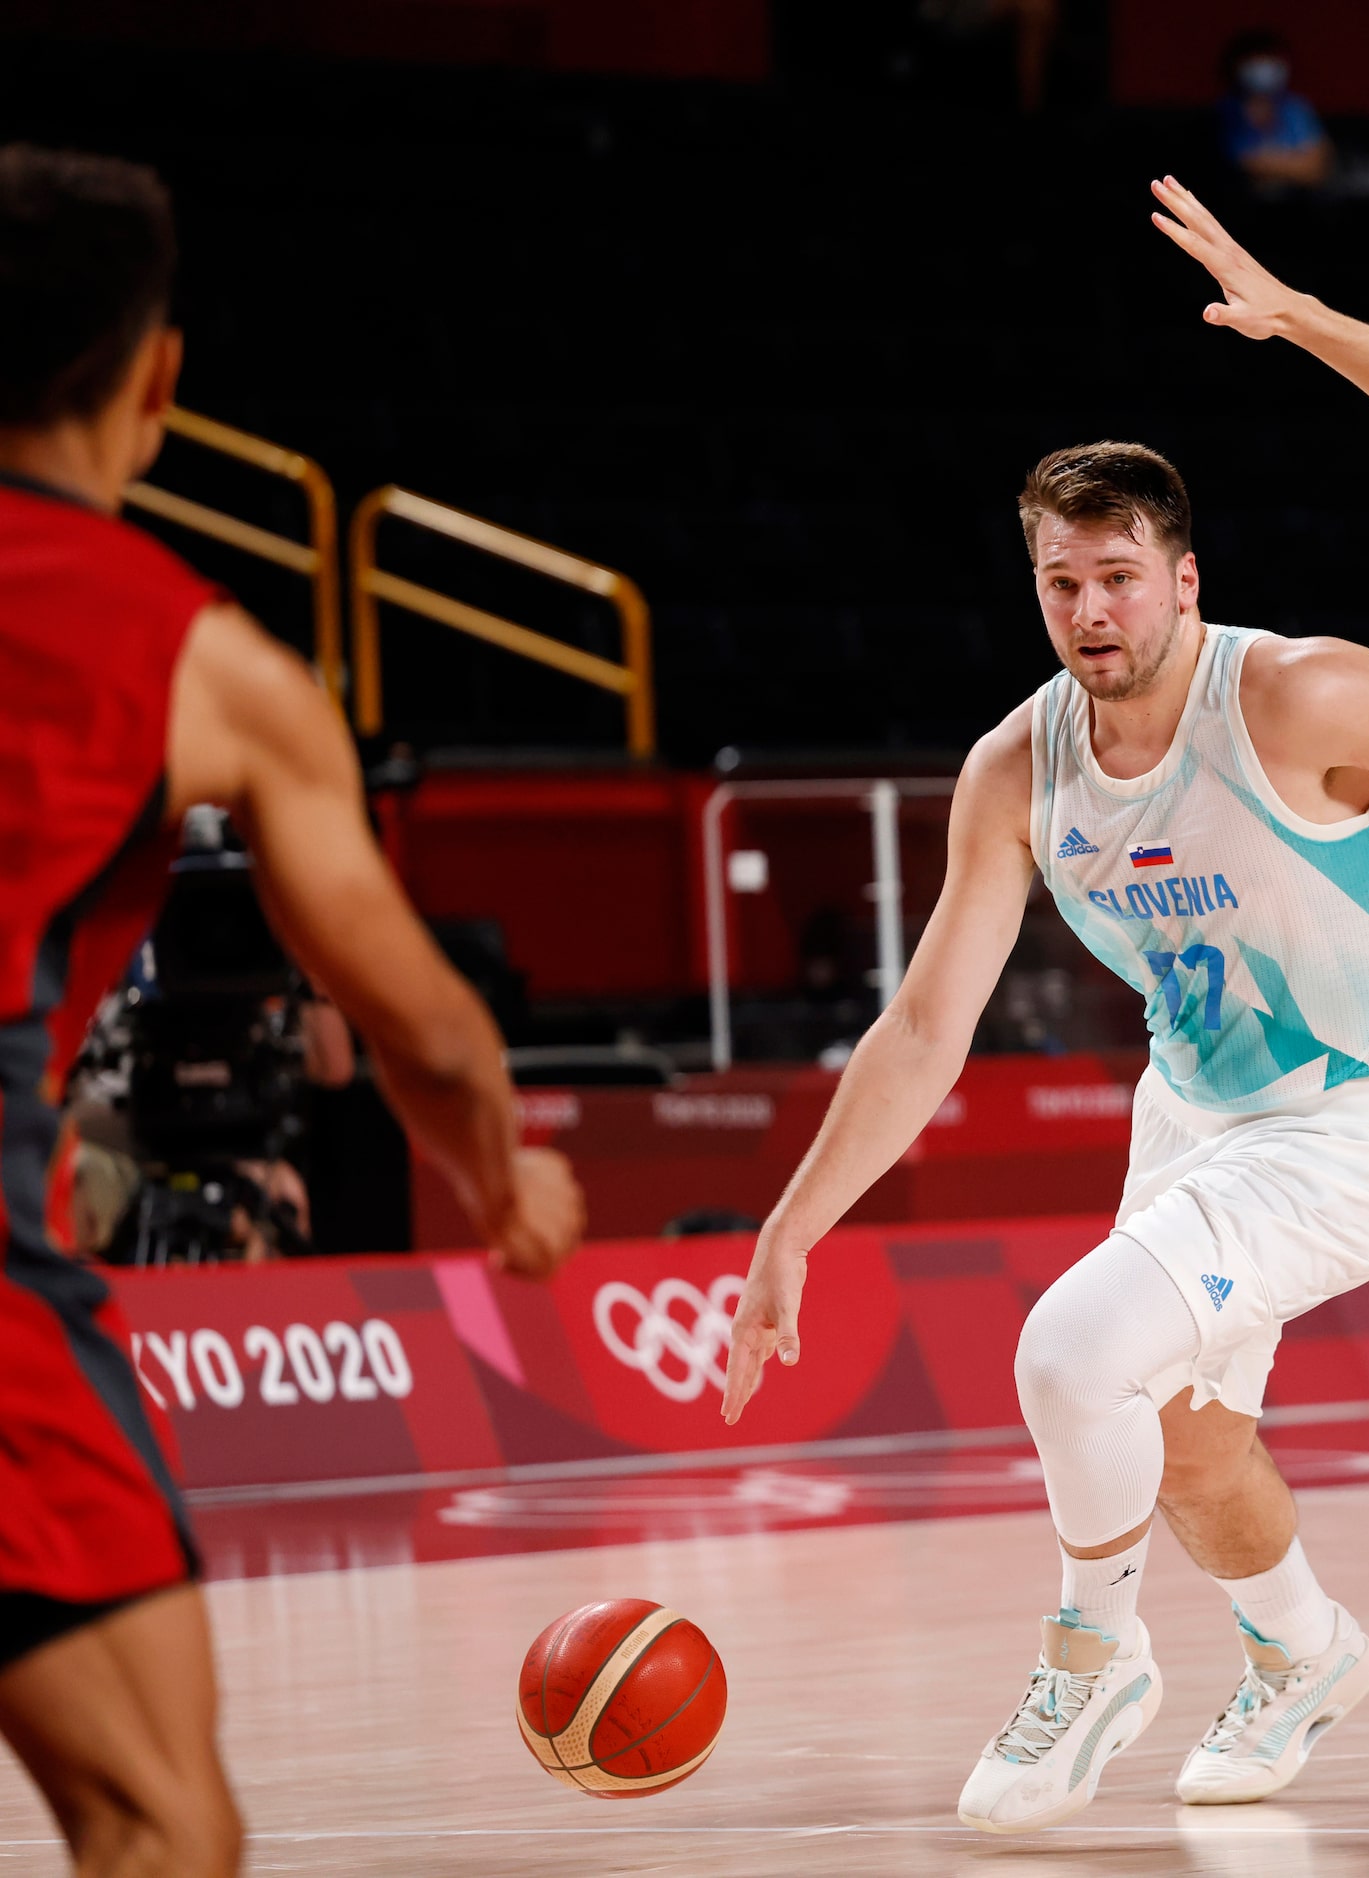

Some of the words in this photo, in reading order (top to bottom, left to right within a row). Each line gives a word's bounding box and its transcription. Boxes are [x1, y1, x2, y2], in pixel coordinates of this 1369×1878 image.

[1056, 840, 1100, 859] adidas
[1087, 872, 1240, 921] SLOVENIA
[1142, 943, 1226, 1031] 77
[243, 1317, 415, 1407] 2020
